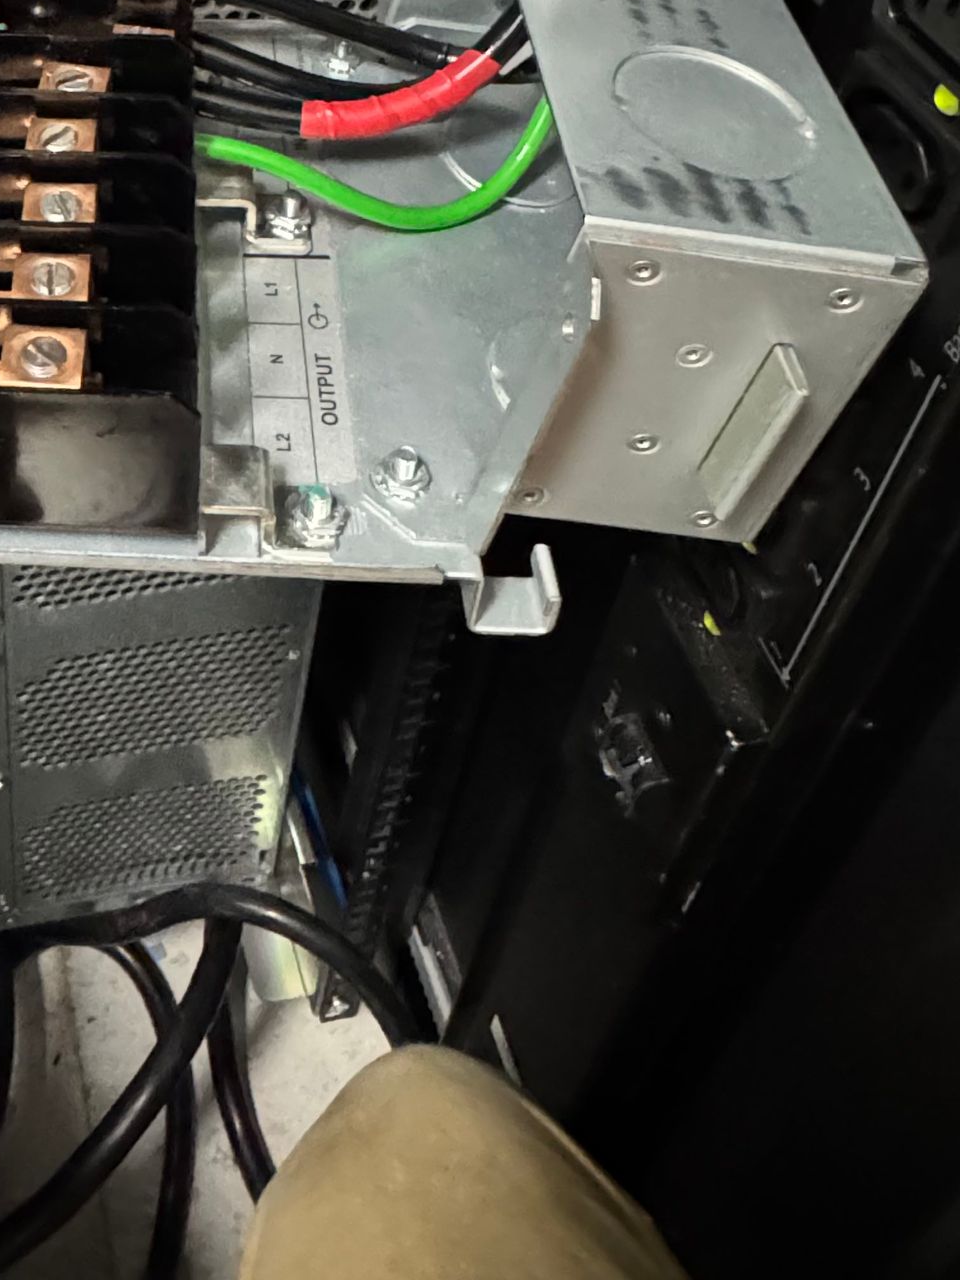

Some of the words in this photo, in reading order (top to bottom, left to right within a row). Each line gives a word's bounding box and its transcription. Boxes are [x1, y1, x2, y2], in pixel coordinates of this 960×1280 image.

[264, 282, 279, 297] L1
[270, 354, 284, 364] N
[315, 353, 339, 426] OUTPUT
[276, 432, 292, 452] L2
